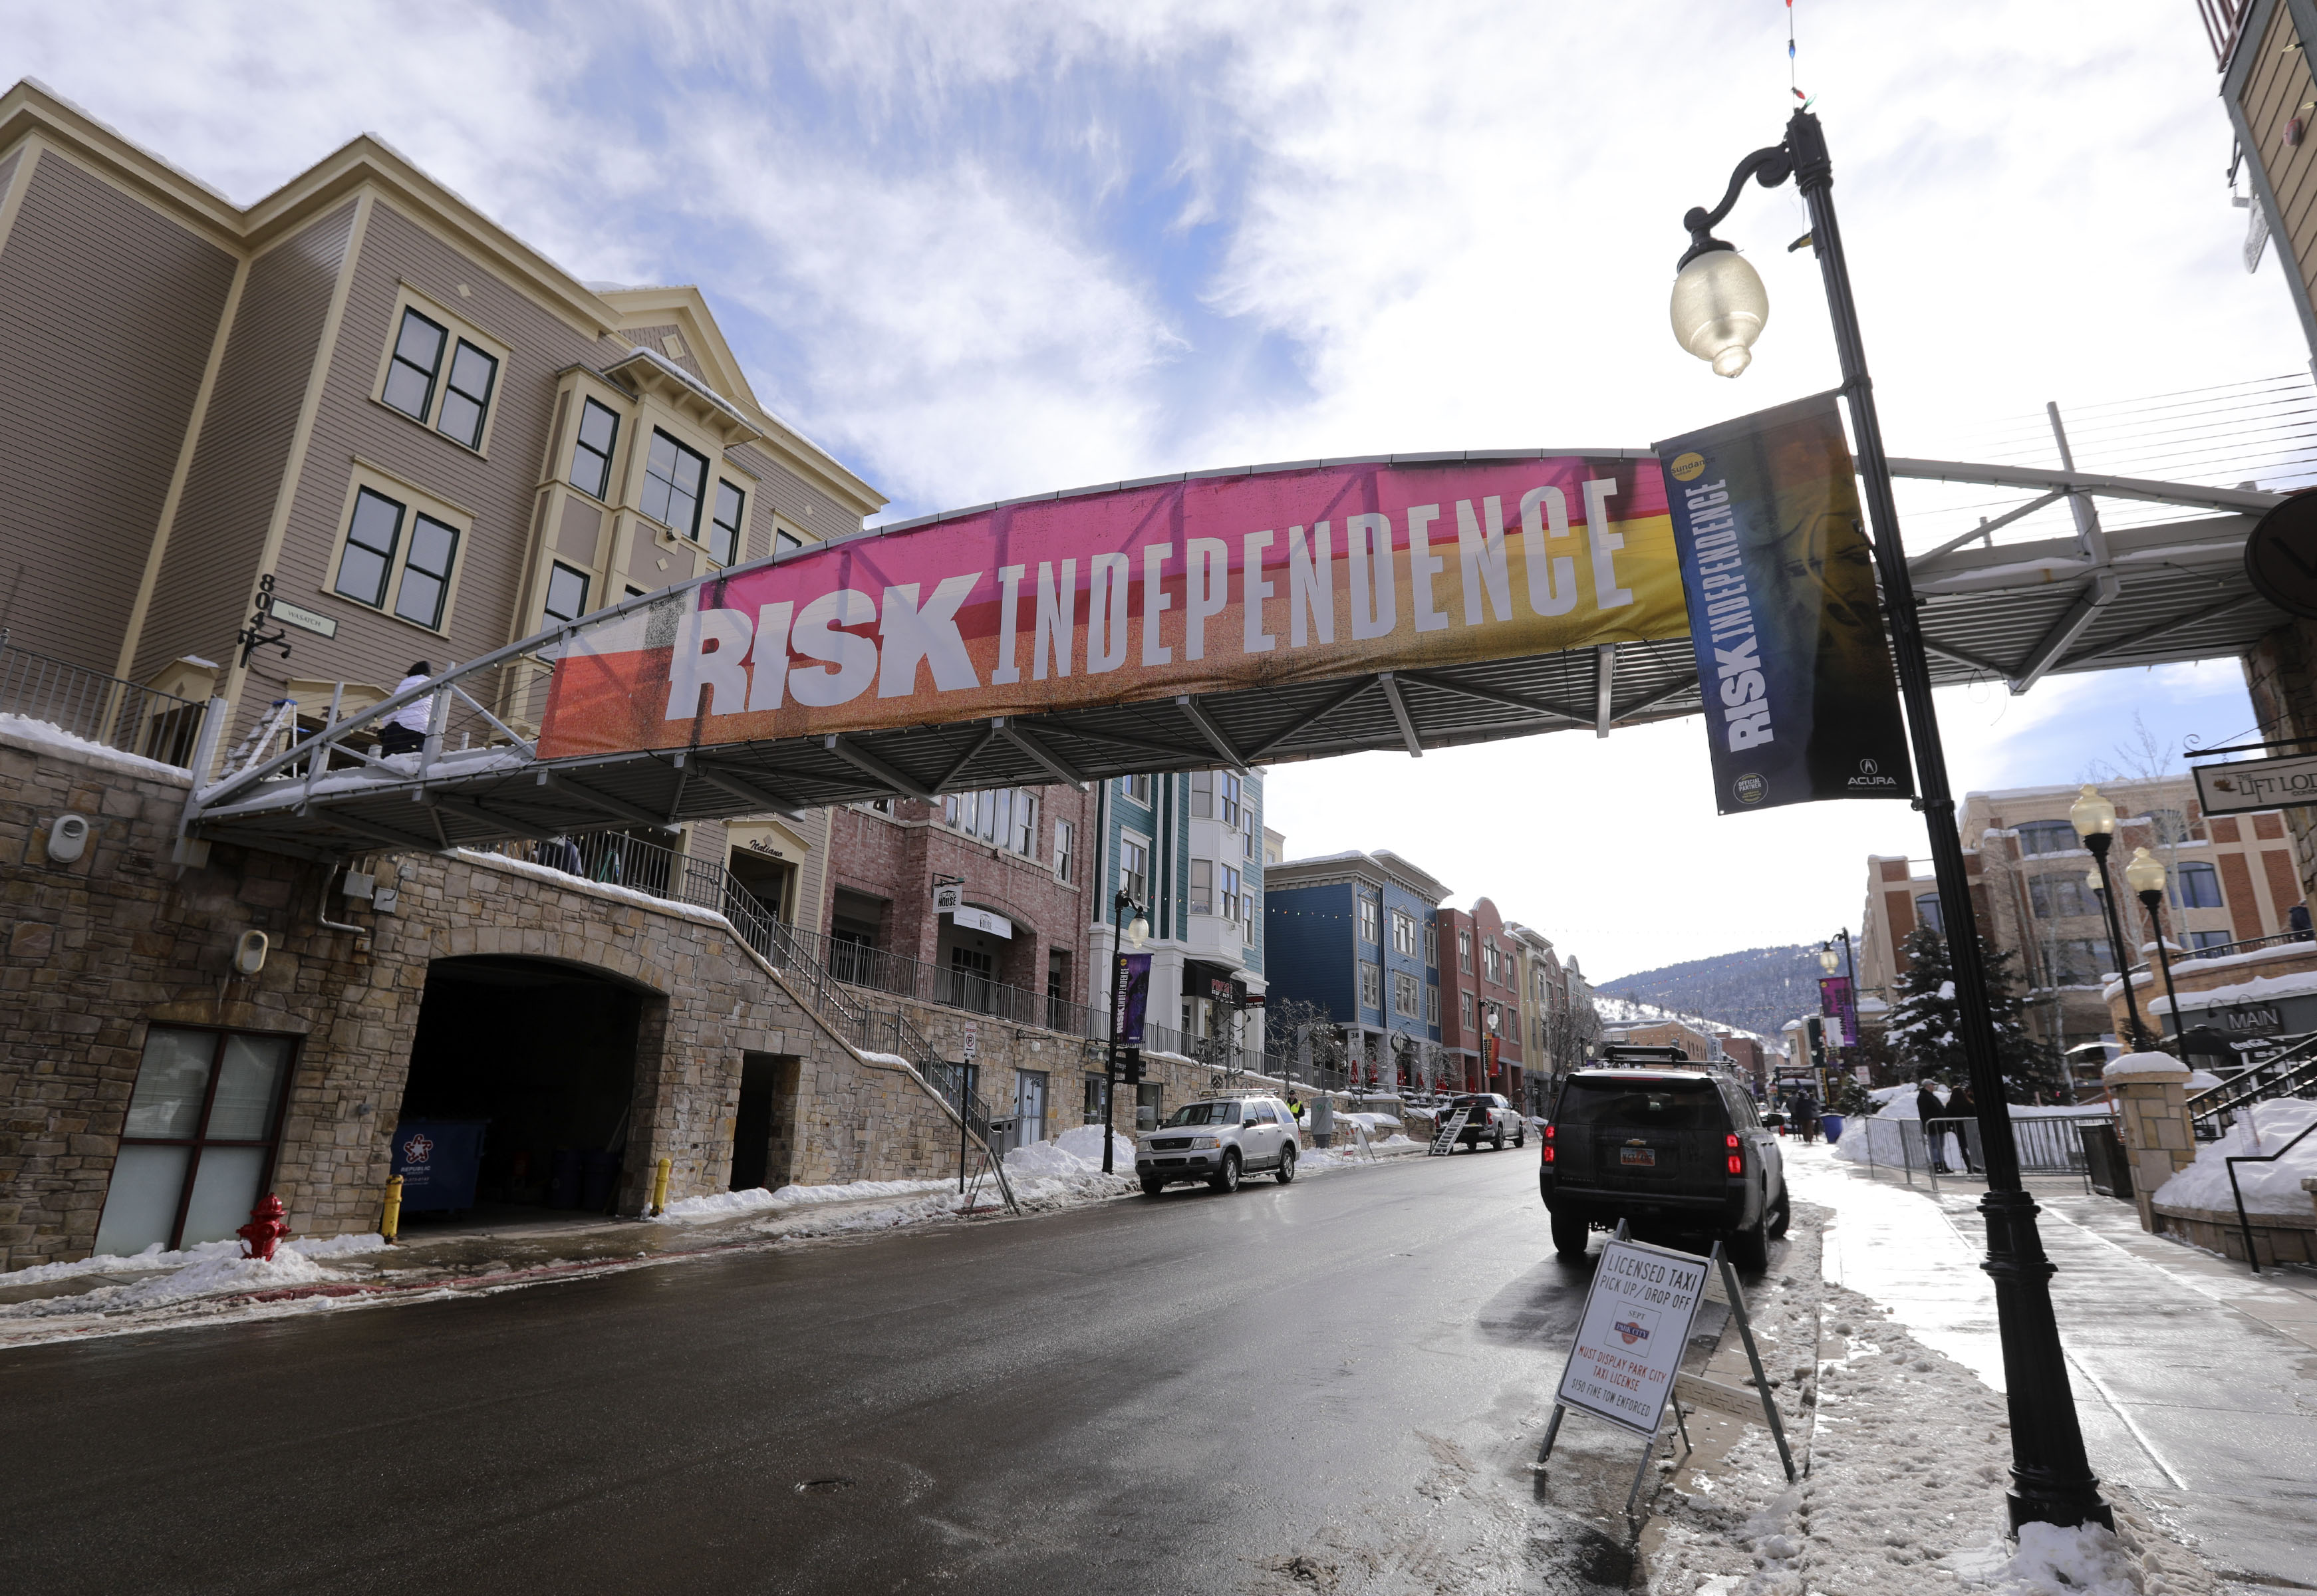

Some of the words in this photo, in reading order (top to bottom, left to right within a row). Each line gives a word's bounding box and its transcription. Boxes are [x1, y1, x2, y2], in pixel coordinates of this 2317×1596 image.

[1671, 457, 1716, 474] sundance
[1685, 479, 1755, 643] INDEPENDENCE
[250, 573, 275, 630] 804
[665, 571, 983, 721] RISK
[992, 477, 1634, 685] INDEPENDENCE
[288, 610, 321, 627] WASATCH
[1714, 635, 1774, 753] RISK
[1738, 777, 1761, 787] OFFICIAL
[1738, 783, 1762, 792] PARTNER
[2239, 778, 2275, 803] LIFT
[750, 839, 783, 857] Italiano
[938, 897, 956, 907] HOUSE
[980, 919, 992, 931] HOUSE
[1118, 968, 1129, 1007] INDEPENDENCE
[1116, 1006, 1125, 1034] RISK
[2229, 1009, 2278, 1029] MAIN
[1115, 1061, 1127, 1071] image
[1607, 1254, 1665, 1283] LICENSED
[1669, 1269, 1698, 1292] TAXI
[1600, 1275, 1622, 1292] PICK
[1623, 1281, 1671, 1305] UP/DROP
[1672, 1294, 1692, 1311] OFF
[1627, 1310, 1646, 1320] SEPT
[1617, 1323, 1631, 1333] PARK
[1632, 1329, 1646, 1338] CITY
[1578, 1345, 1597, 1361] MUST
[1597, 1351, 1627, 1371] DISPLAY
[1628, 1362, 1648, 1379] PARK
[1649, 1369, 1667, 1385] CITY
[1593, 1365, 1609, 1381] TAXI
[1609, 1371, 1641, 1392] LICENSE
[1571, 1378, 1586, 1393] $150
[1586, 1383, 1602, 1399] FINE
[1602, 1389, 1617, 1404] TOW
[1616, 1395, 1651, 1417] ENFORCED
